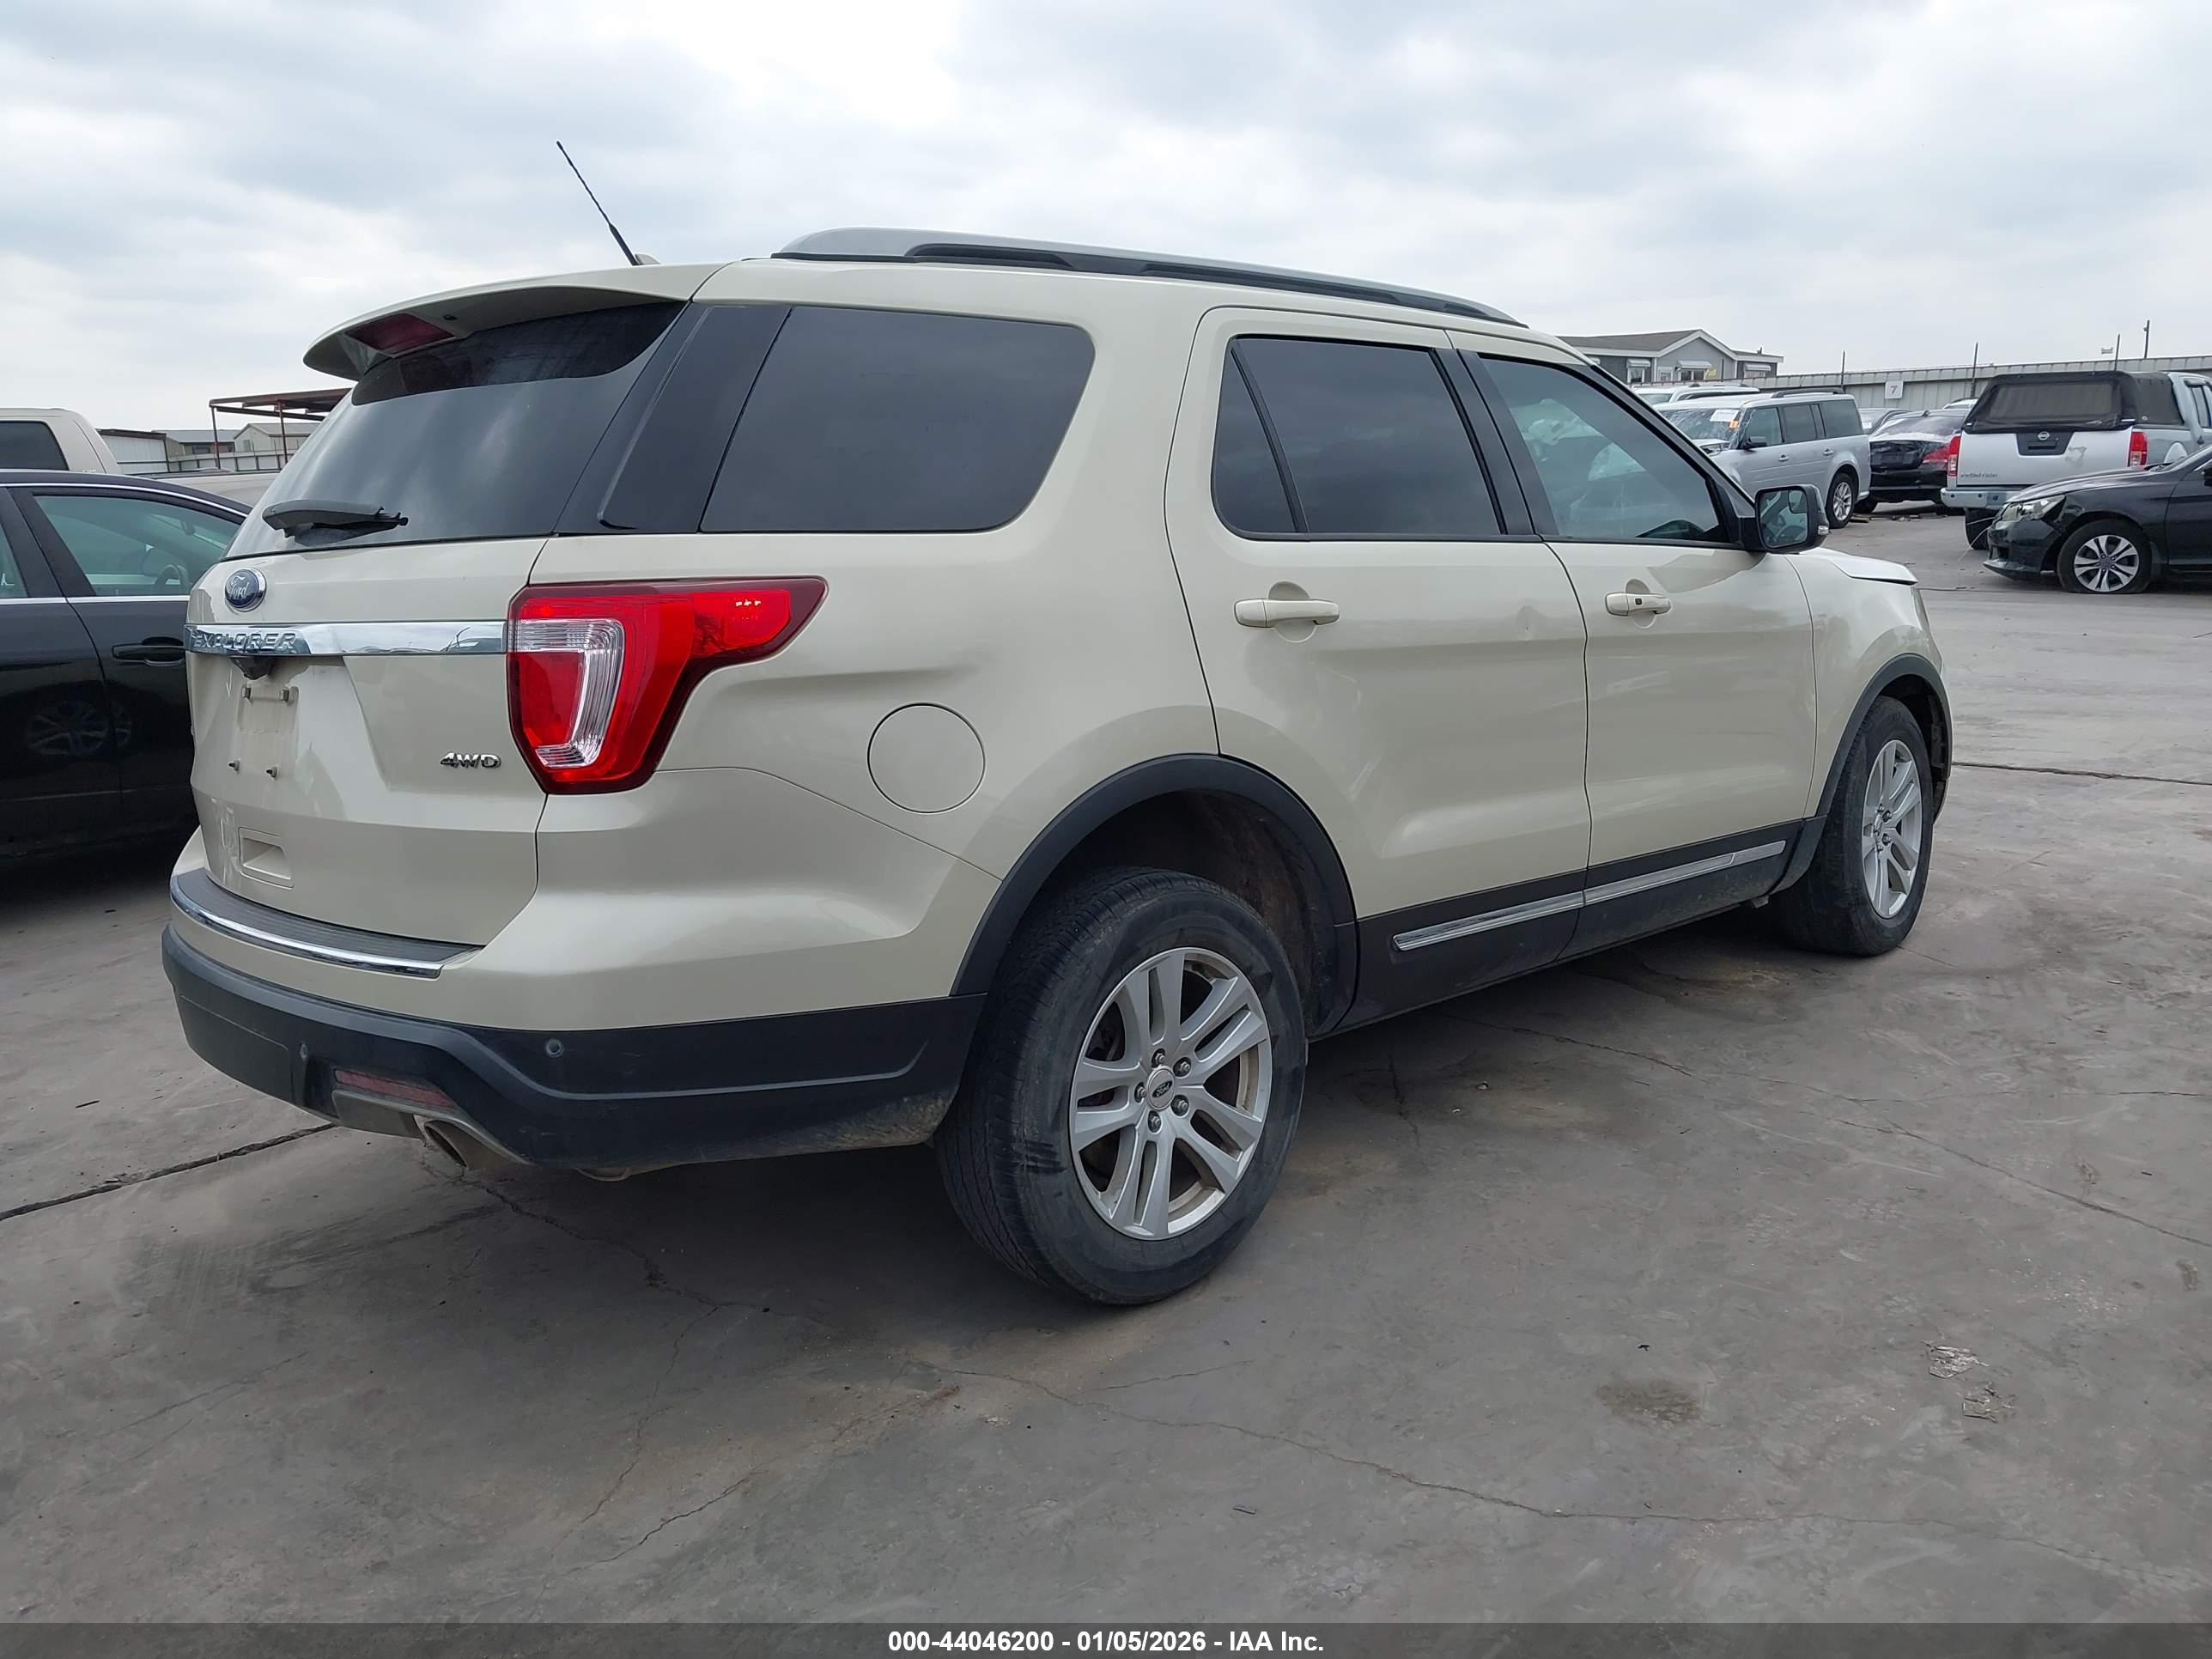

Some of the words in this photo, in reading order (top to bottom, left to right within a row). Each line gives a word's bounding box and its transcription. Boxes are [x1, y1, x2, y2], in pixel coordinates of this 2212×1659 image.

[1891, 385, 1898, 395] 7
[227, 575, 250, 599] Ford
[191, 632, 297, 652] EXPLORER
[440, 752, 501, 769] 4WD
